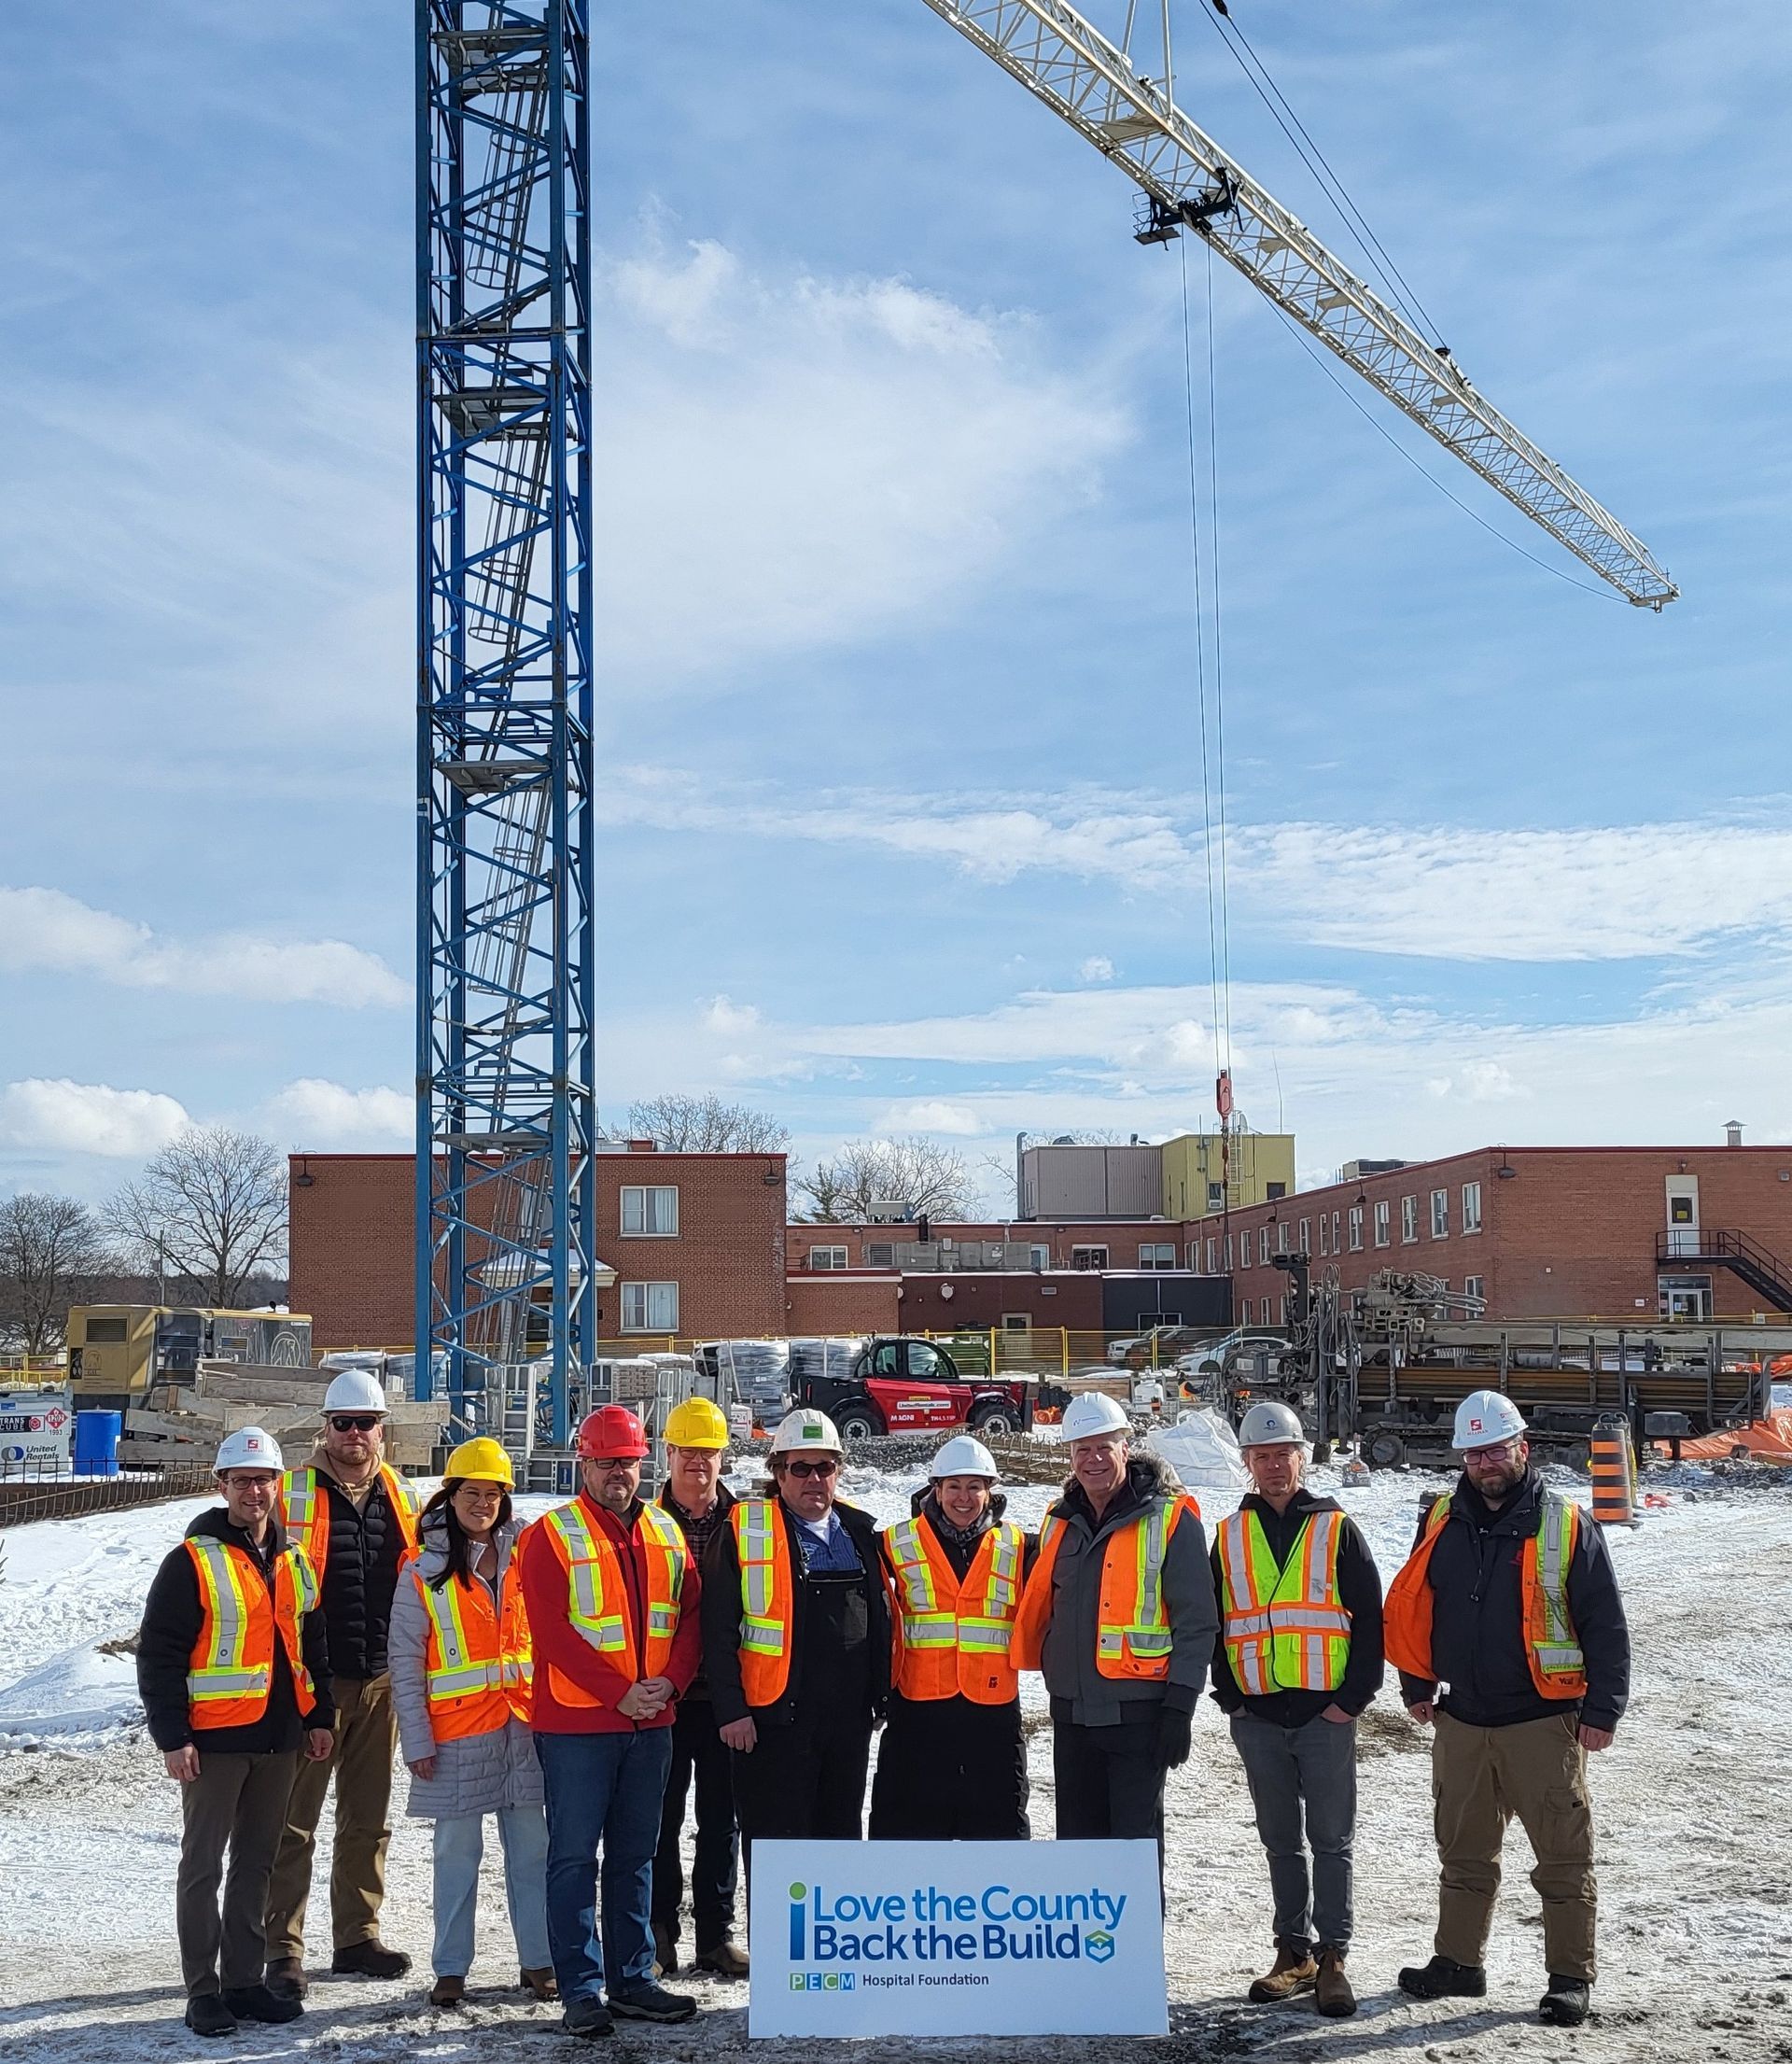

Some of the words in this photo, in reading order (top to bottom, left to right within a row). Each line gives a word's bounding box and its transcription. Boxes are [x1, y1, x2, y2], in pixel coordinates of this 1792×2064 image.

[26, 1444, 57, 1453] United
[26, 1453, 60, 1461] Rentals
[814, 1886, 906, 1922] Love
[912, 1886, 976, 1922] the
[981, 1885, 1127, 1931] County
[814, 1925, 909, 1960] Back
[912, 1924, 977, 1960] the
[983, 1924, 1081, 1960] Build
[791, 1973, 856, 1990] PECM
[862, 1974, 915, 1988] Hospital
[918, 1973, 989, 1987] Foundation
